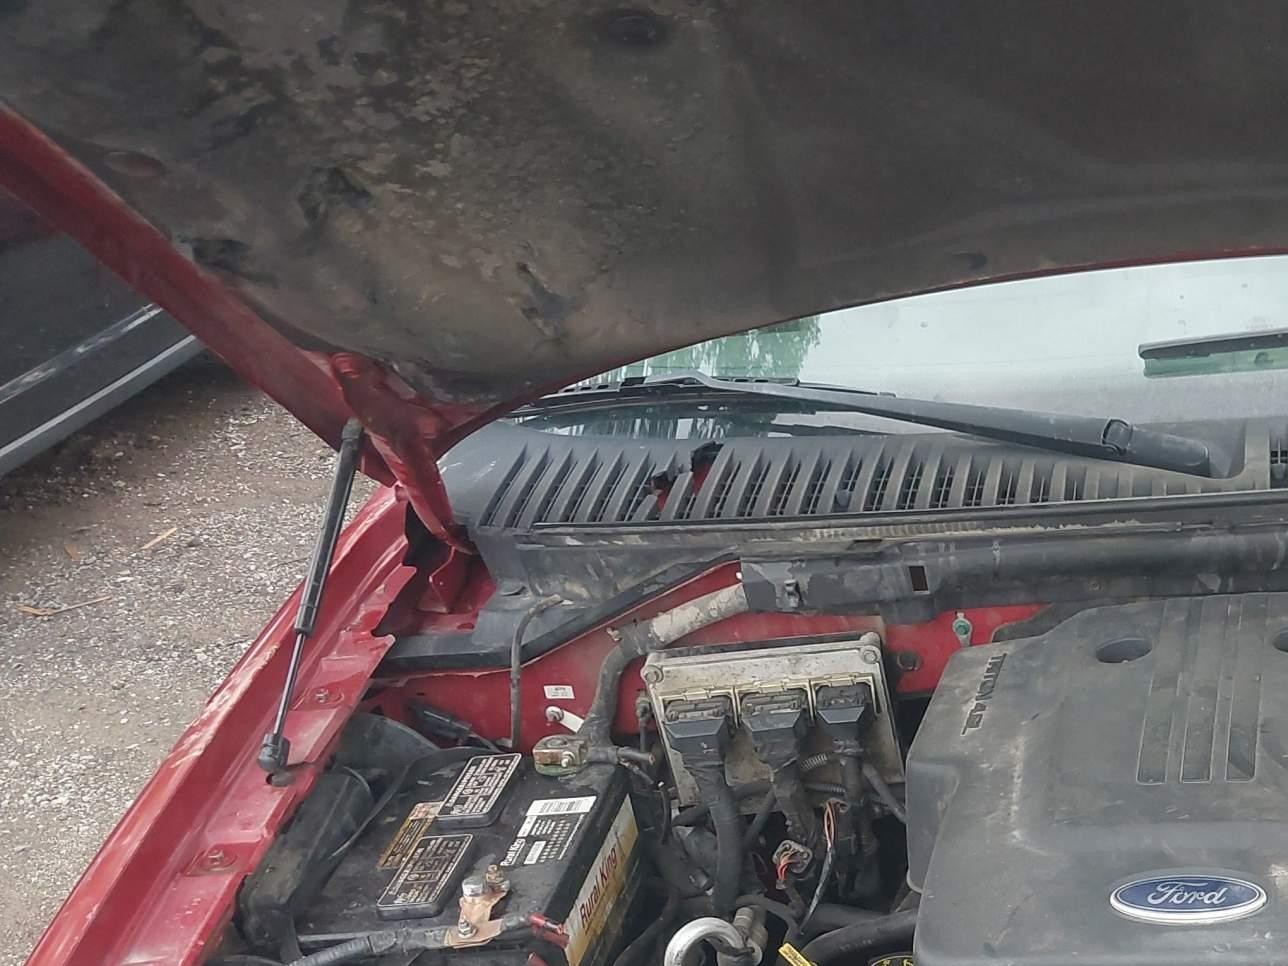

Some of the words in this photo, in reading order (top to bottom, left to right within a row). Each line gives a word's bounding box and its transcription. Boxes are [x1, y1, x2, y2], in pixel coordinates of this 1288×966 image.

[579, 879, 600, 925] Rural
[600, 847, 618, 887] King
[1147, 881, 1228, 904] Ford
